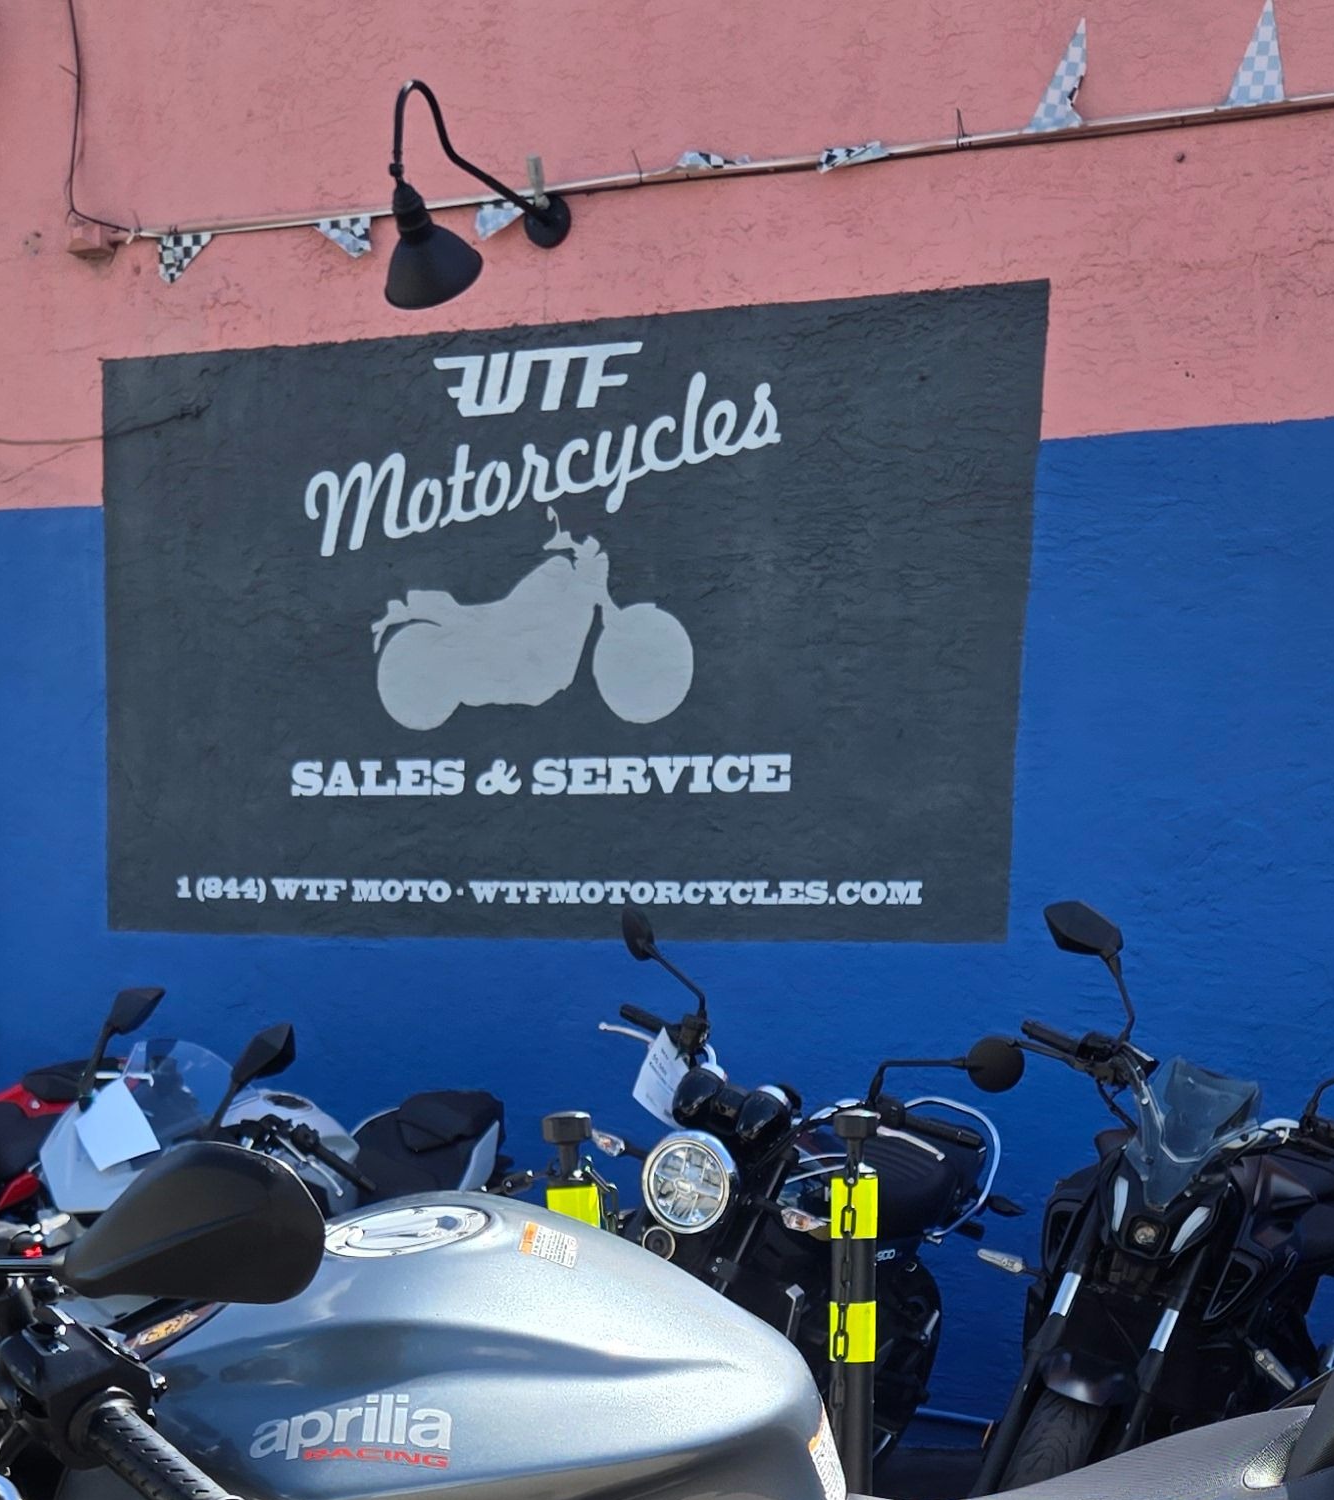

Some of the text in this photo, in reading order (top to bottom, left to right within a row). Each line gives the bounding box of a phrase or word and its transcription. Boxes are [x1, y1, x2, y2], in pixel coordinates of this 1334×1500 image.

[434, 341, 644, 417] WTF
[304, 371, 782, 557] Motorcycles
[290, 752, 792, 797] SALES & SERVICE
[176, 875, 923, 905] 1 (844) WTF MOTO WTFMOTORCYCLES.COM
[249, 1394, 452, 1461] aprilia
[302, 1446, 450, 1469] RACING
